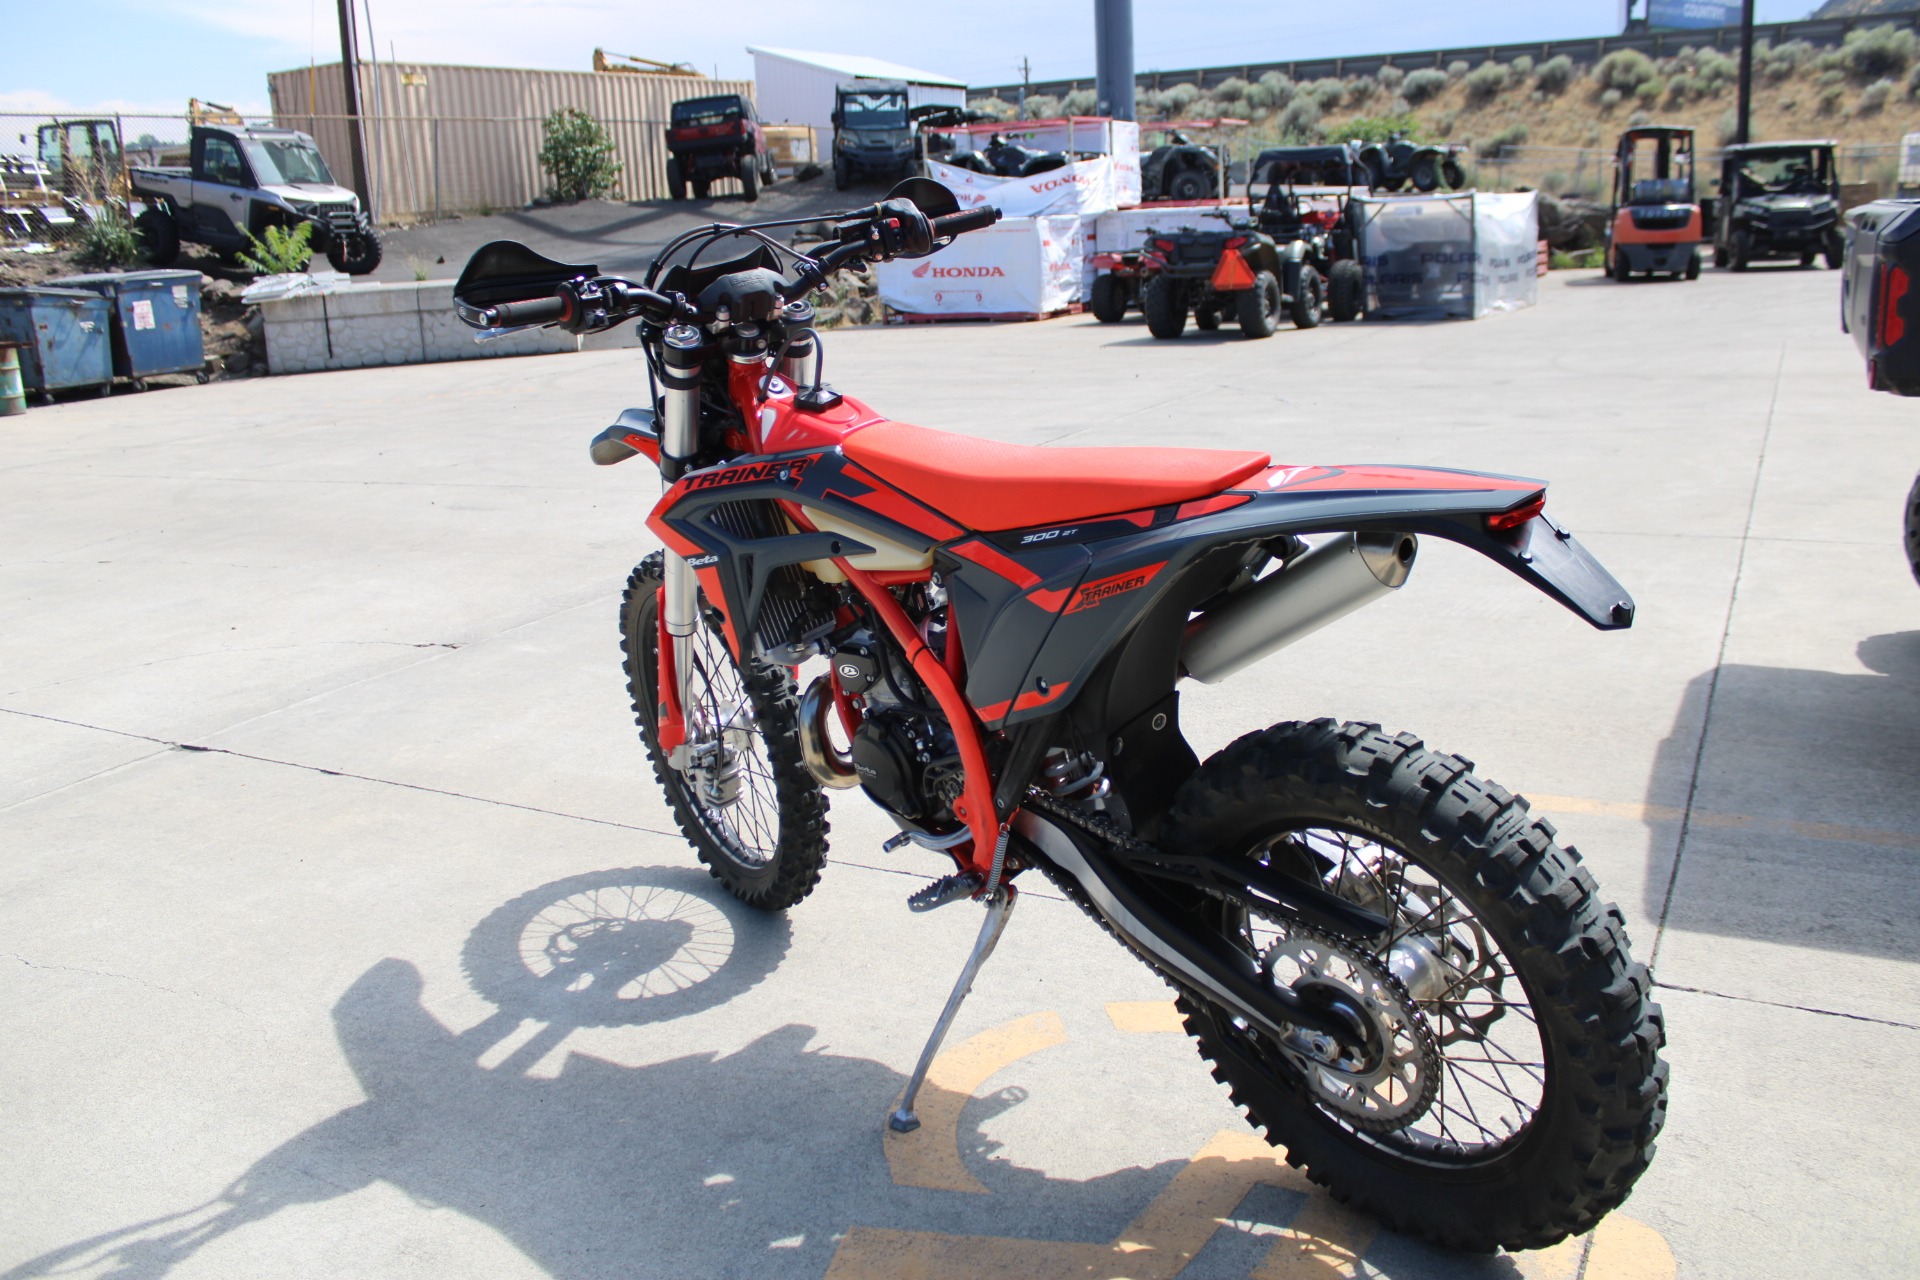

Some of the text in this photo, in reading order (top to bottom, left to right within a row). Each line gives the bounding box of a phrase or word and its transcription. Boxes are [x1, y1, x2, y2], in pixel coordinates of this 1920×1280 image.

[932, 266, 1005, 278] HONDA
[1021, 530, 1060, 544] 300
[687, 555, 719, 567] Beta
